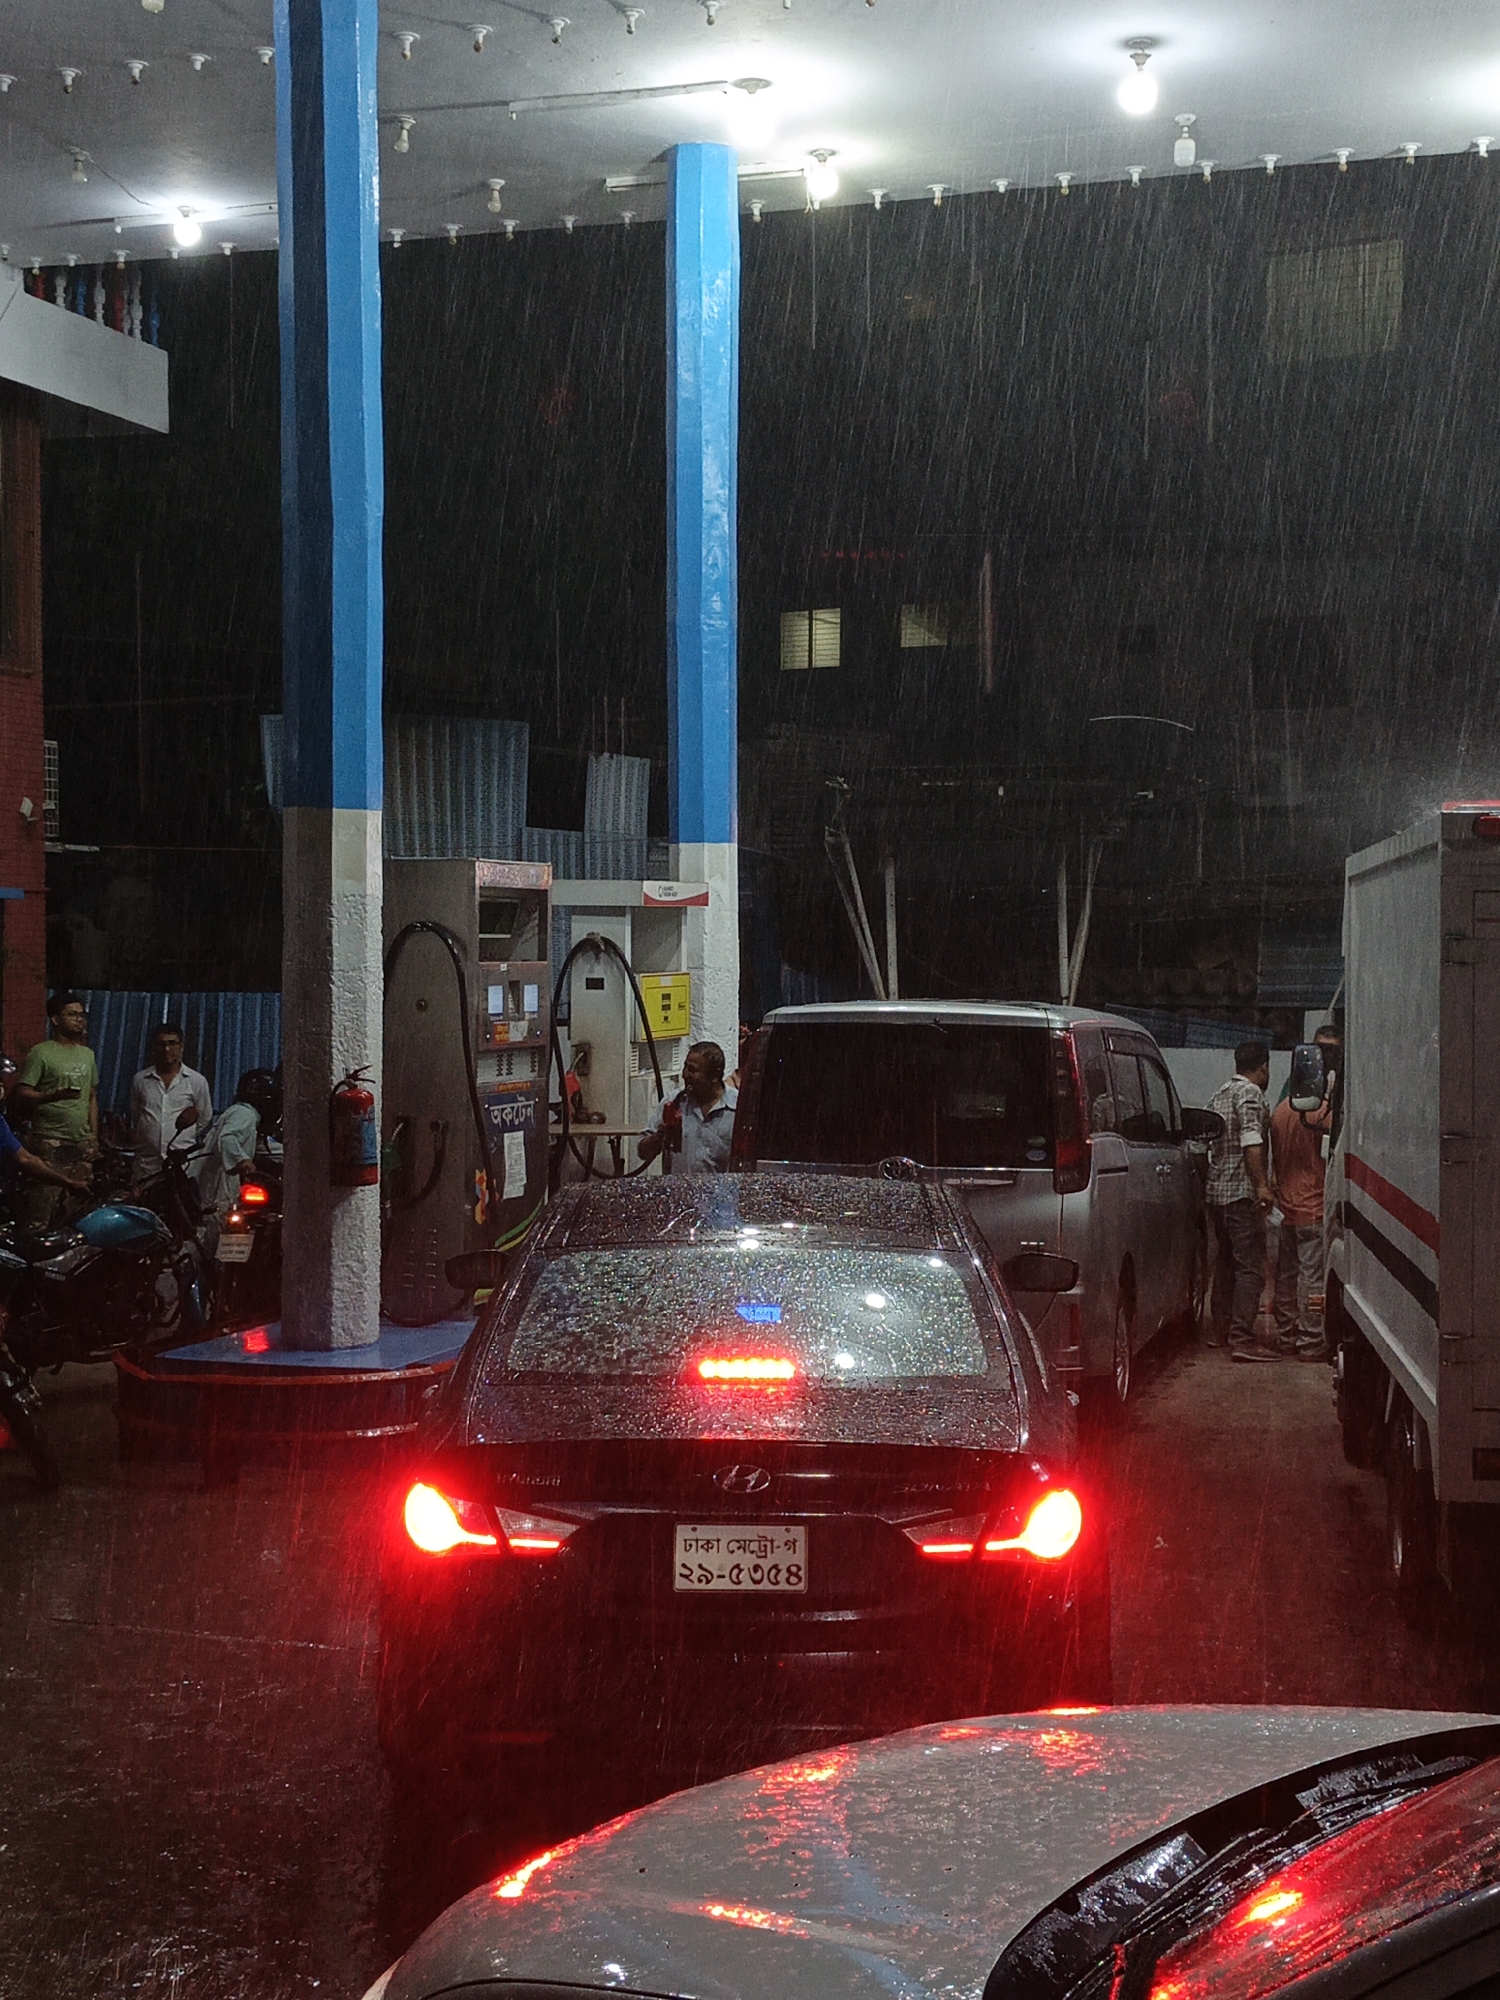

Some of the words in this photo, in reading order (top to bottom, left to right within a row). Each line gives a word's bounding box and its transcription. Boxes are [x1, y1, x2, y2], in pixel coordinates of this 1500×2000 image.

[489, 1094, 535, 1128] অকটেন
[683, 1536, 721, 1554] ঢাকা
[727, 1533, 798, 1560] মেট্রো-গ
[679, 1562, 803, 1586] ২৯-৫৩৫৪
